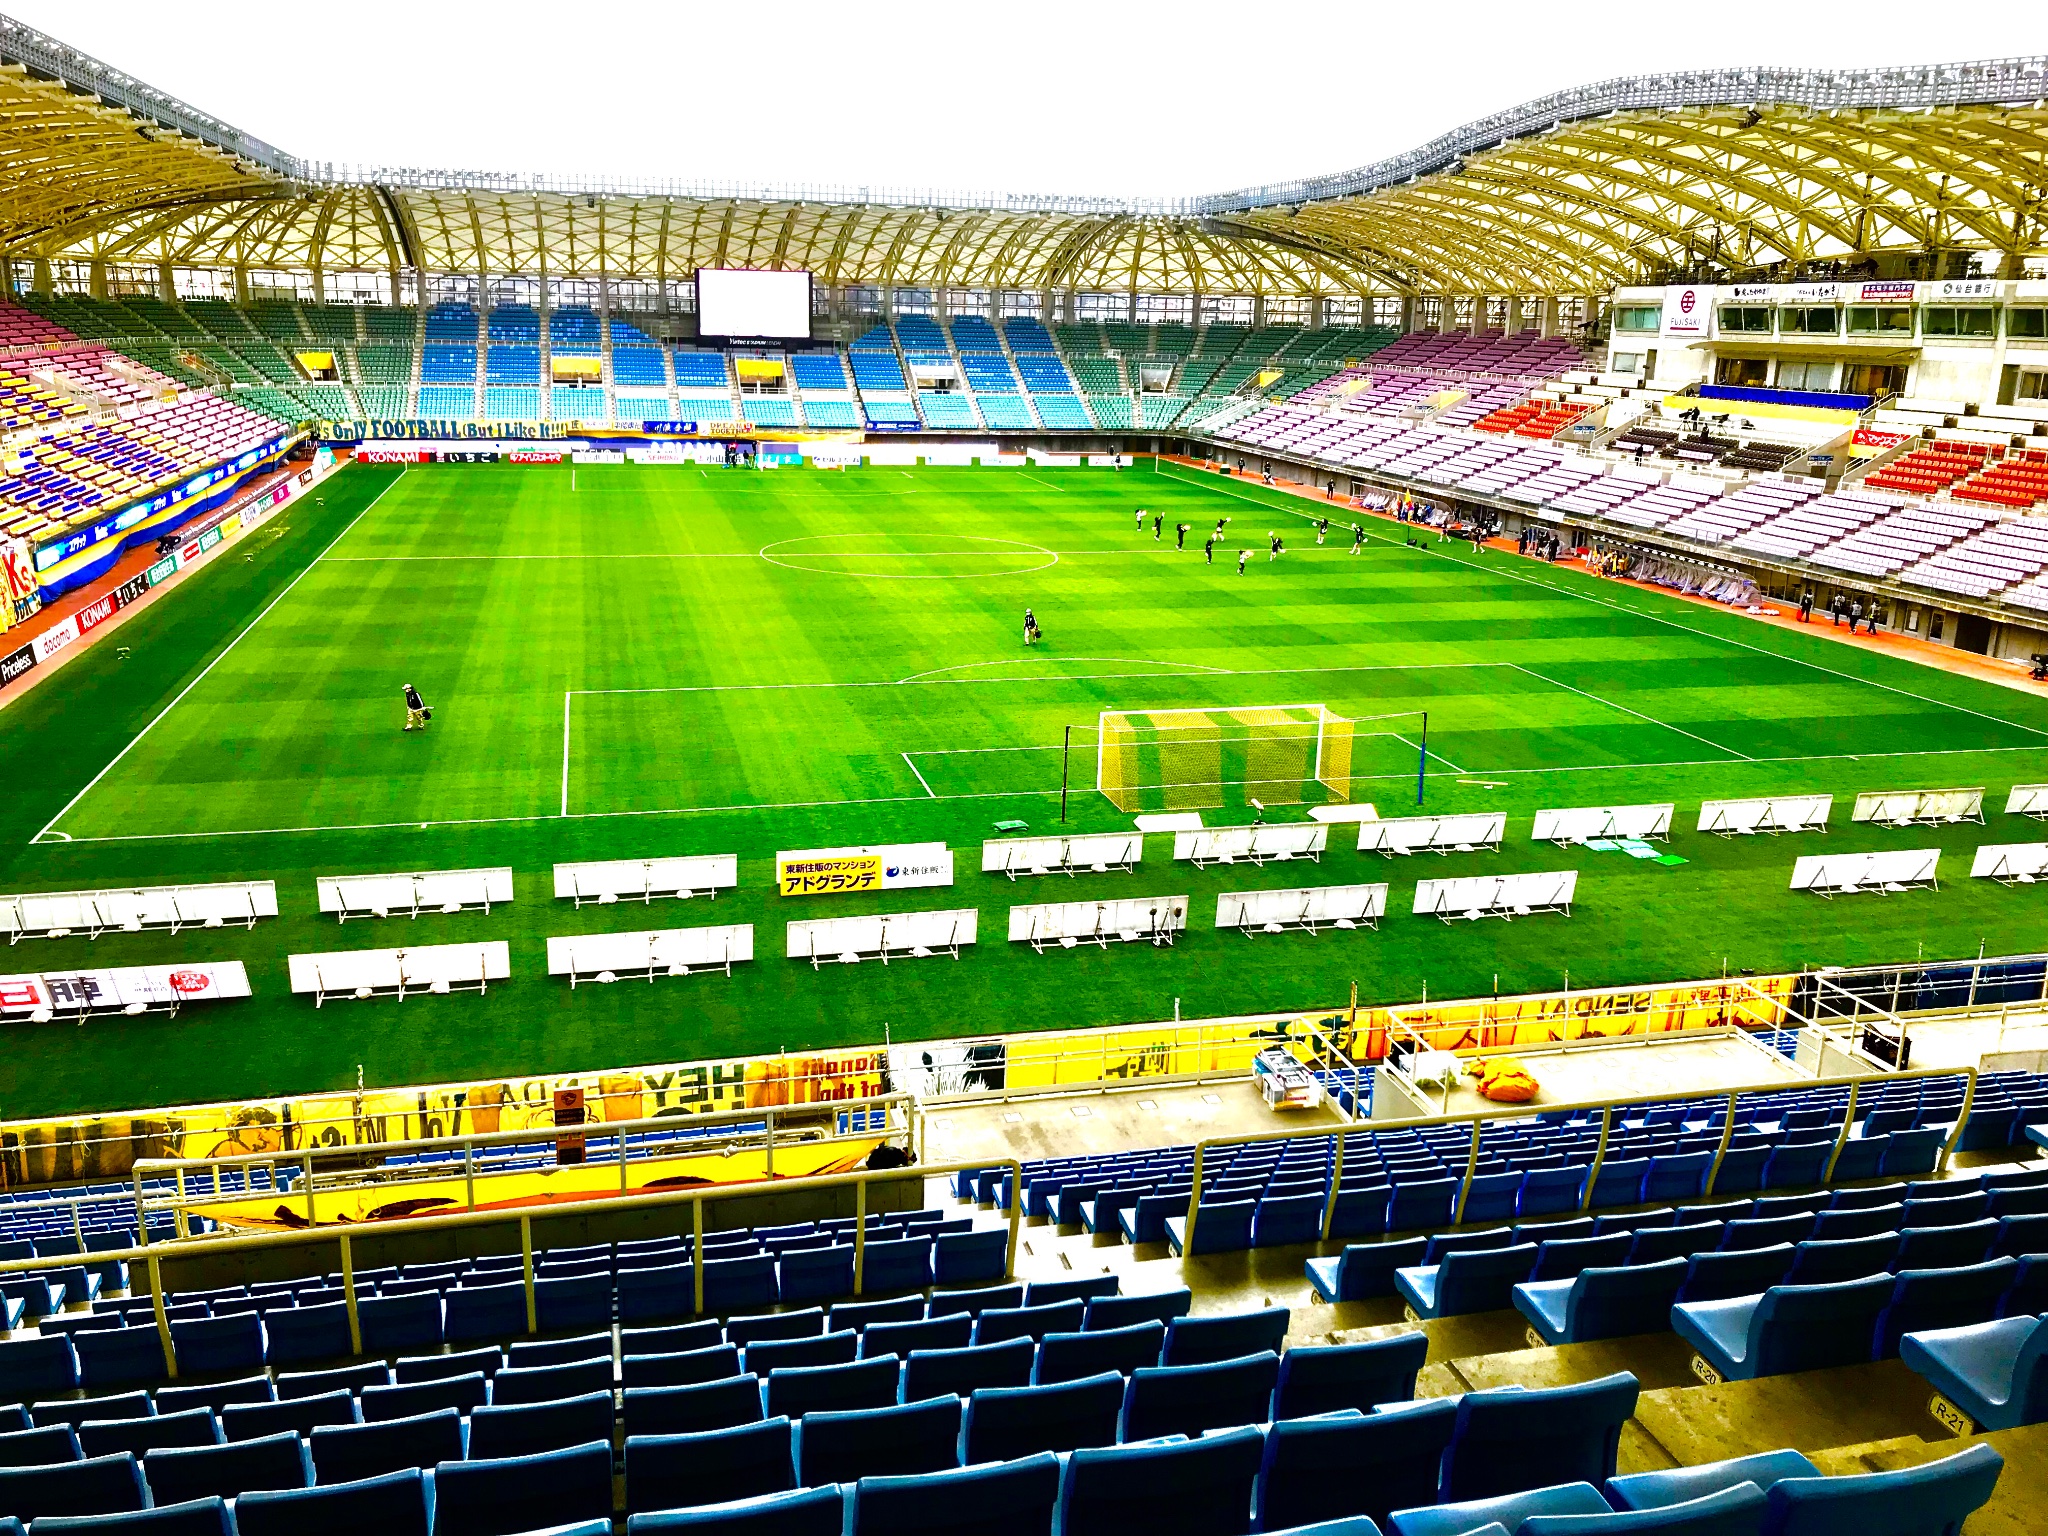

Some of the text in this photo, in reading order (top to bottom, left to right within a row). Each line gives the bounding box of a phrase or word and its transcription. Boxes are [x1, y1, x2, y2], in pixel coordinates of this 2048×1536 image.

[1670, 317, 1701, 326] FUJISAKI
[332, 420, 366, 441] Only
[371, 420, 461, 439] FOOTBALL
[505, 421, 536, 439] Like
[367, 452, 420, 463] KONAMI
[449, 452, 491, 463] いちご
[122, 576, 145, 605] いちご
[80, 597, 112, 630] KONAMI
[43, 627, 71, 654] docomo
[785, 860, 876, 875] 東新住販のマンション
[786, 872, 876, 893] アドグランデ
[1695, 1360, 1717, 1385] R-20
[1935, 1402, 1965, 1433] R-21
